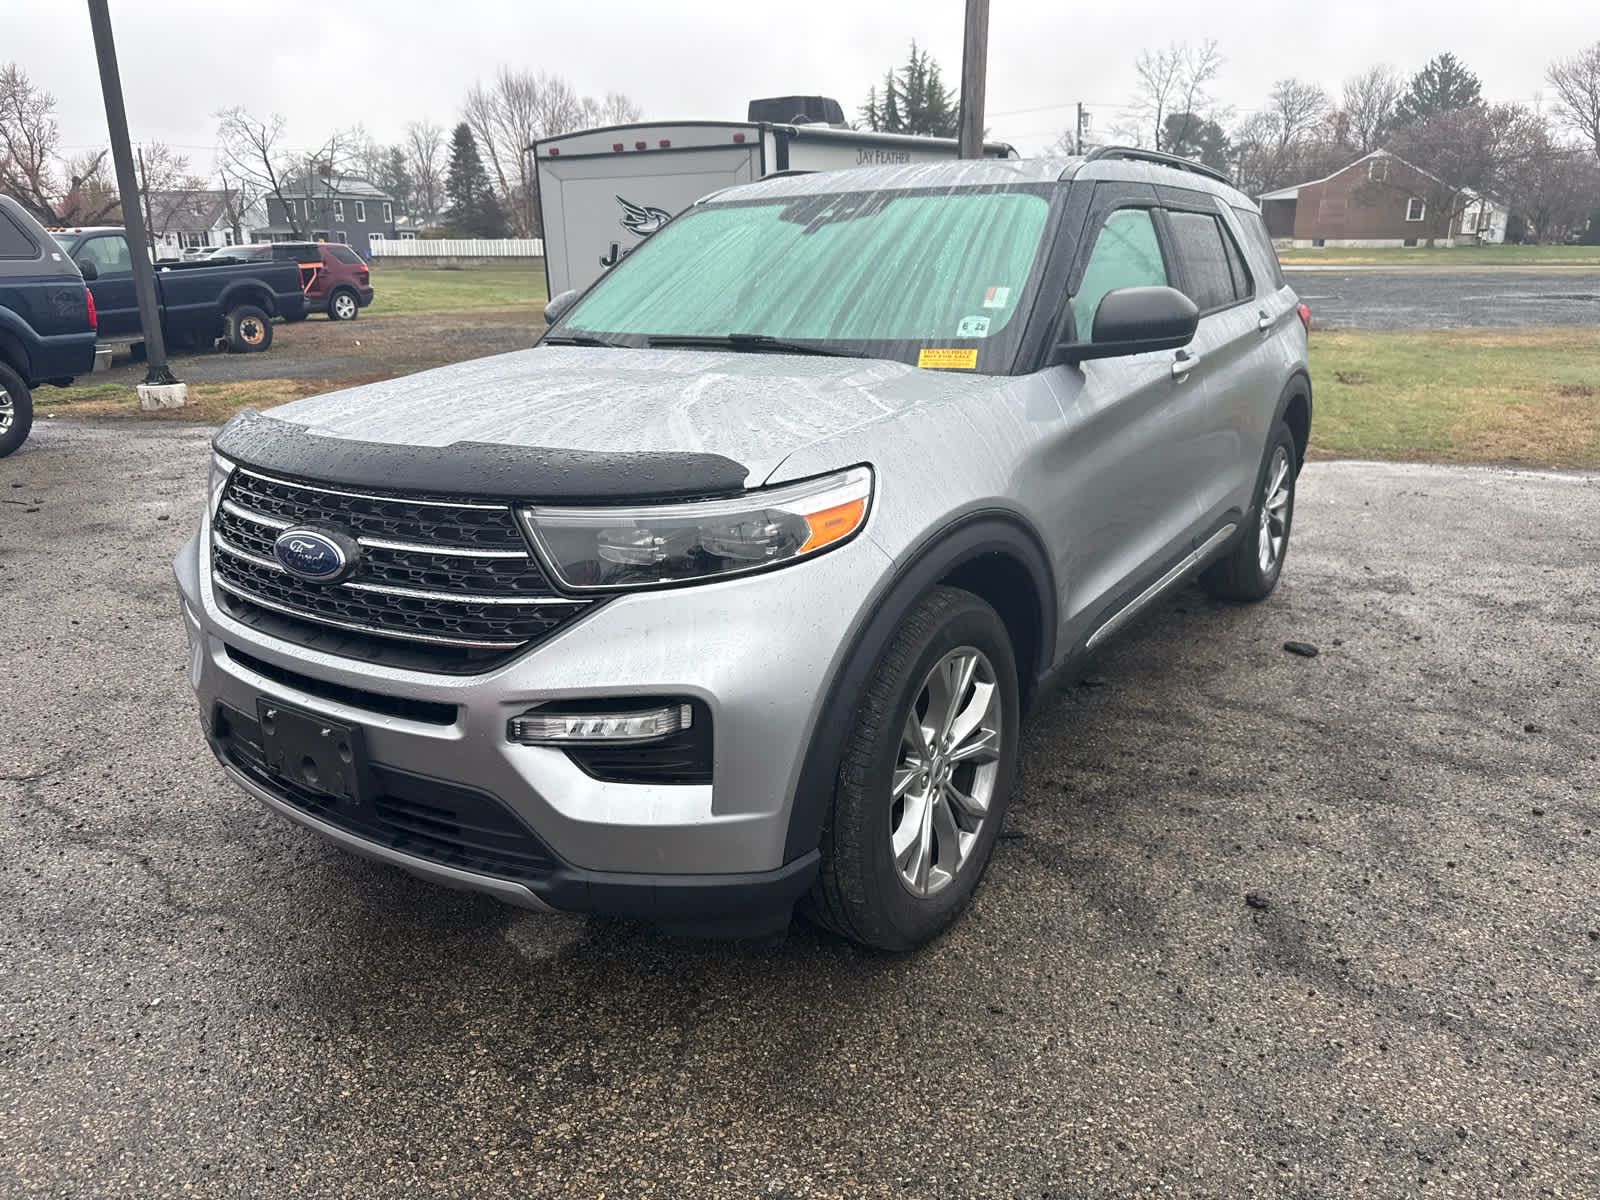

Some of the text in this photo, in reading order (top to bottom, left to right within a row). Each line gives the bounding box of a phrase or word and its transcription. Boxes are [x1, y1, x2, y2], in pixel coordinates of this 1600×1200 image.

[856, 148, 911, 165] JAY FEATHER
[288, 539, 326, 566] Ford
